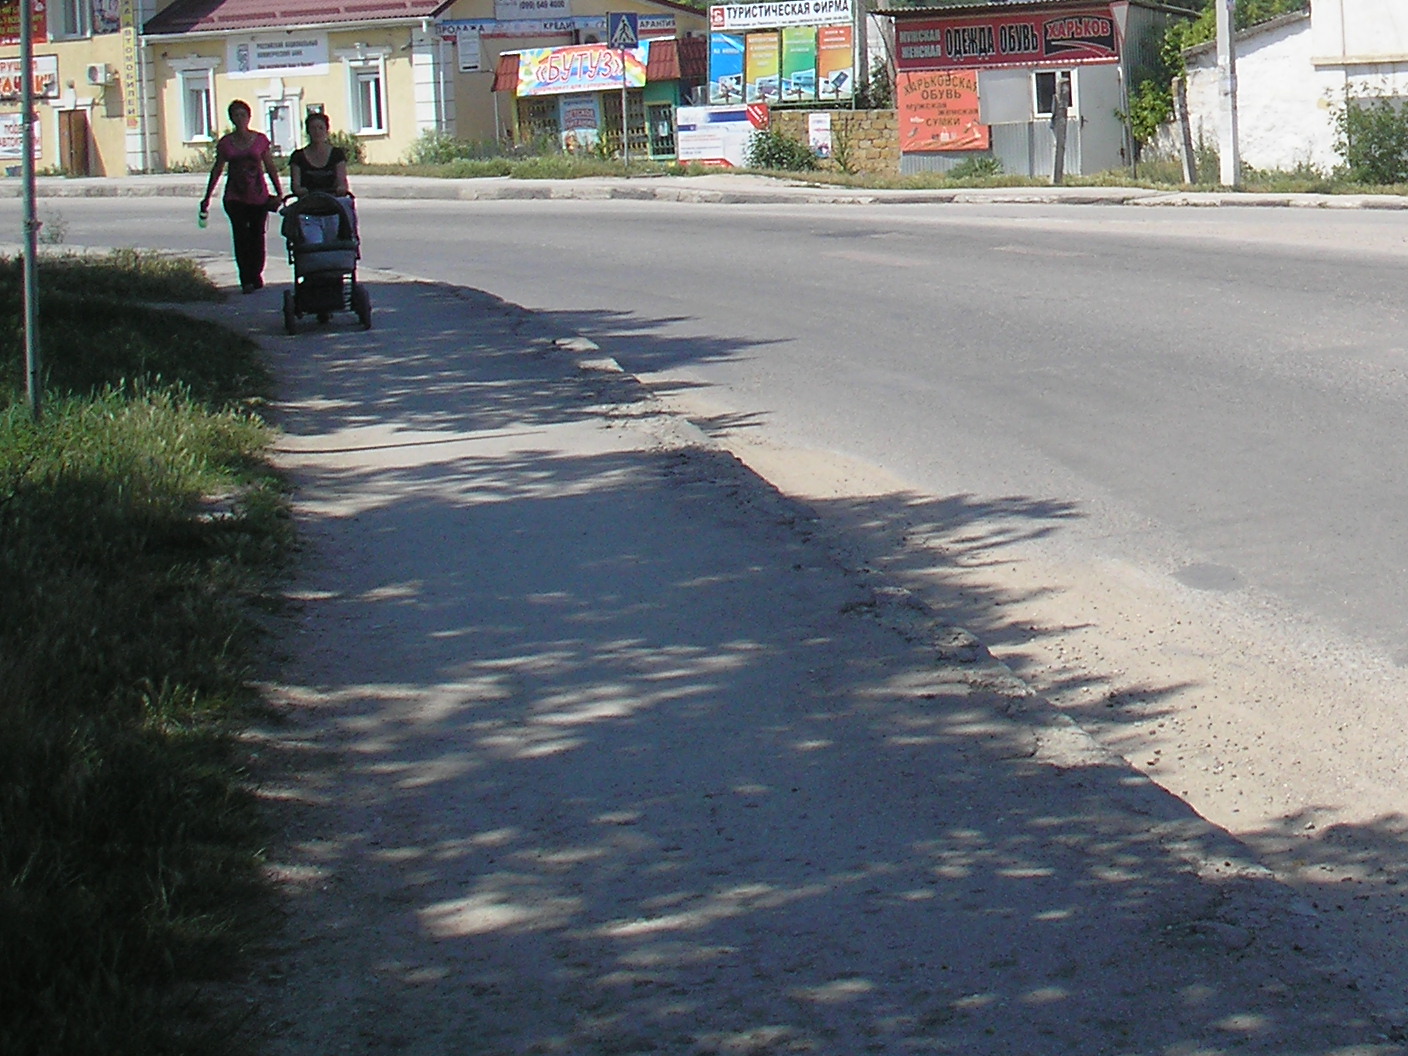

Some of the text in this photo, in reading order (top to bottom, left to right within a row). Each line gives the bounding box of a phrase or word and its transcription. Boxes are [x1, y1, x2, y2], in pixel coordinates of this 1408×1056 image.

[727, 0, 849, 20] ТУРИСТИЧЕСКАЯ ФИРМА
[543, 21, 576, 30] КРЕДИТ
[639, 19, 676, 29] АРАНТИЯ
[1046, 18, 1110, 39] ХАРЬКОВ
[945, 23, 1038, 61] ОДЕЖДА ОБУВЬ
[921, 89, 962, 100] ОБУВЬ
[926, 118, 961, 127] СУМКИ
